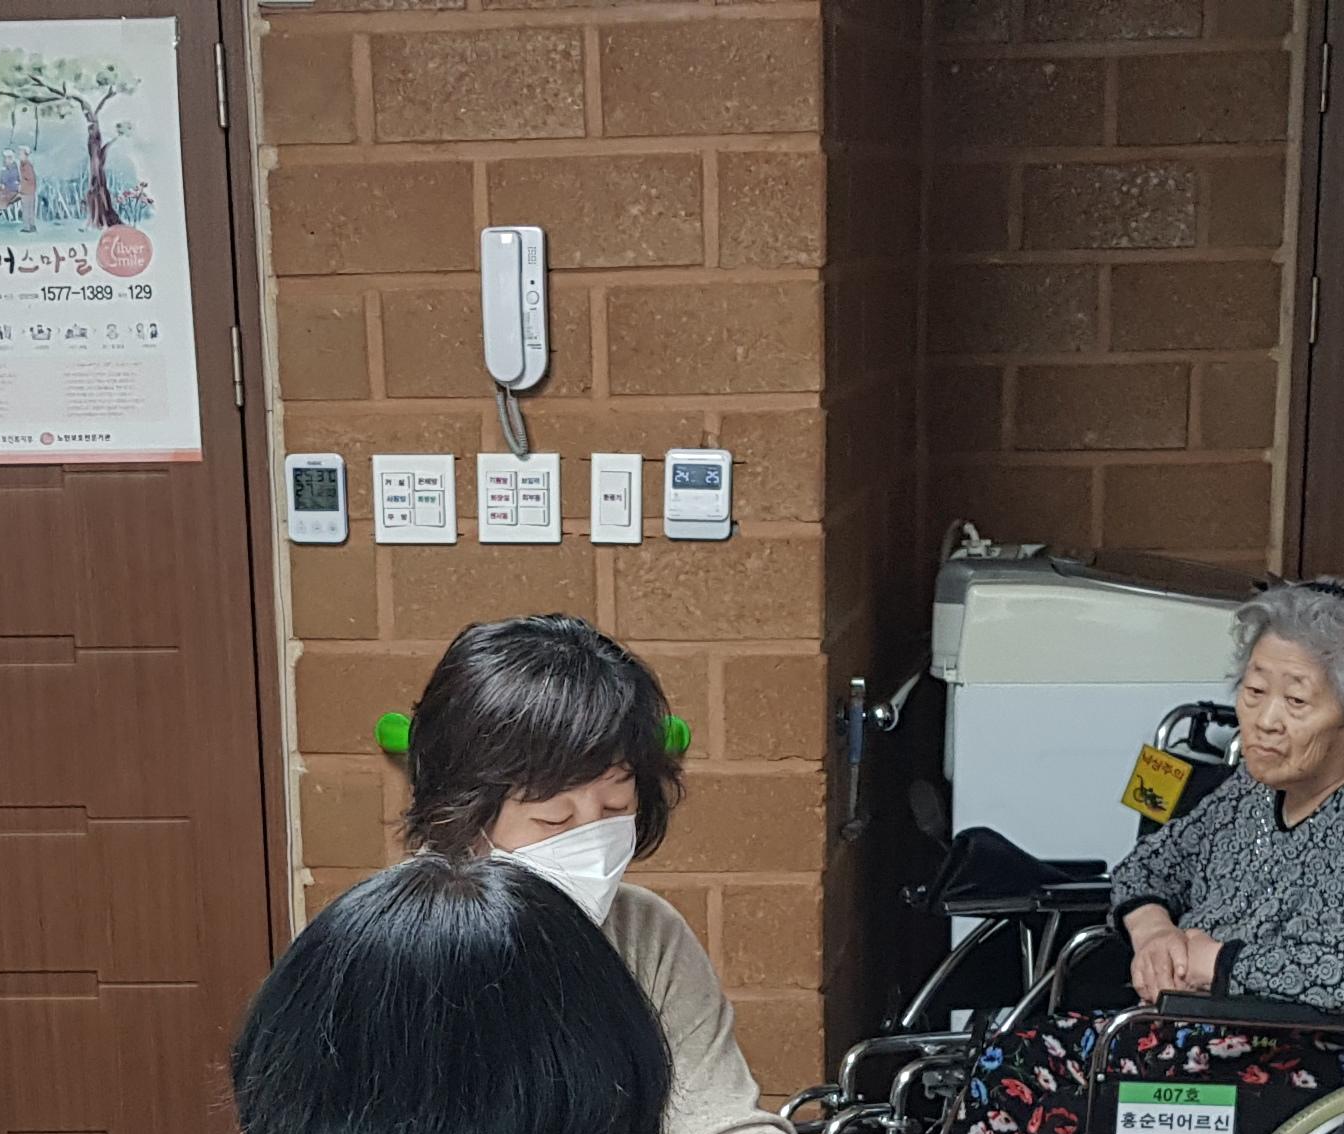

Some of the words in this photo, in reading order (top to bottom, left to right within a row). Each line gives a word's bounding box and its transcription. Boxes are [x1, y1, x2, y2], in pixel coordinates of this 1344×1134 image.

[41, 285, 113, 301] 1577-1389
[128, 285, 152, 299] 129
[675, 470, 689, 482] 24
[705, 471, 719, 483] 25
[1153, 1088, 1199, 1103] 407호
[1121, 1112, 1229, 1131] 홍순덕어르신
